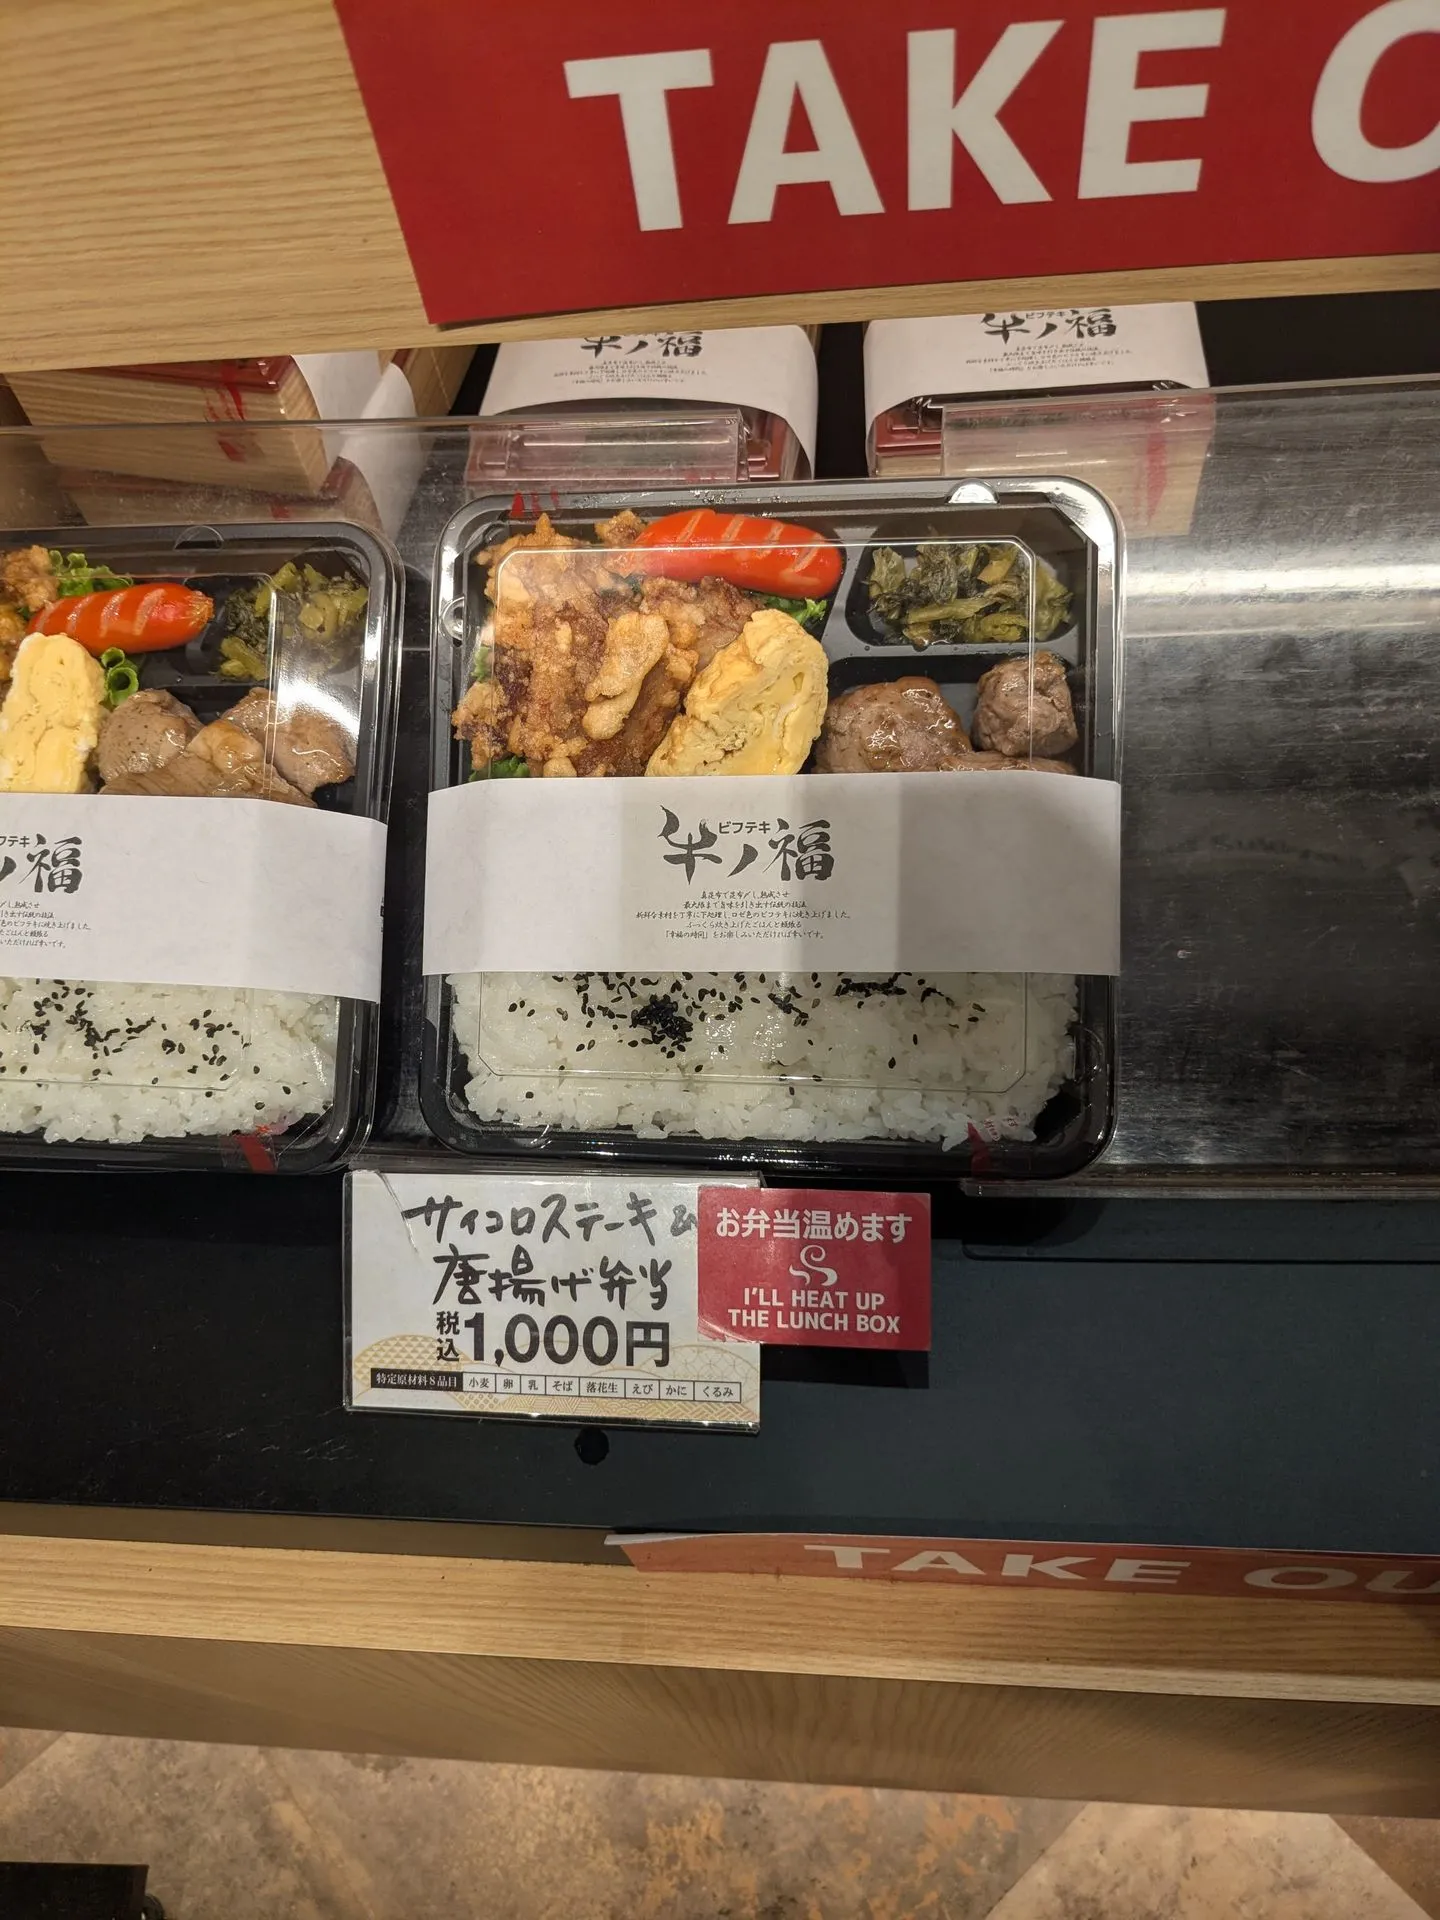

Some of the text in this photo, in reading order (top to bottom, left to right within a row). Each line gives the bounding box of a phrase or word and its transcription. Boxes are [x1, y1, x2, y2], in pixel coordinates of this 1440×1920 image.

[564, 8, 1225, 231] TAKE
[719, 820, 771, 834] ビフテキ
[716, 1207, 912, 1243] お弁当温めます
[432, 1244, 672, 1311] 唐揚げ弁当
[744, 1287, 885, 1311] I'LL HEAT UP
[727, 1308, 900, 1334] THE LUNCH BOX
[464, 1311, 670, 1368] 1,000円
[376, 1372, 734, 1398] 特定原材料8品目 小麦 卵 乳 そば 落花生 えび かに くるみ
[803, 1544, 1191, 1585] TAKE
